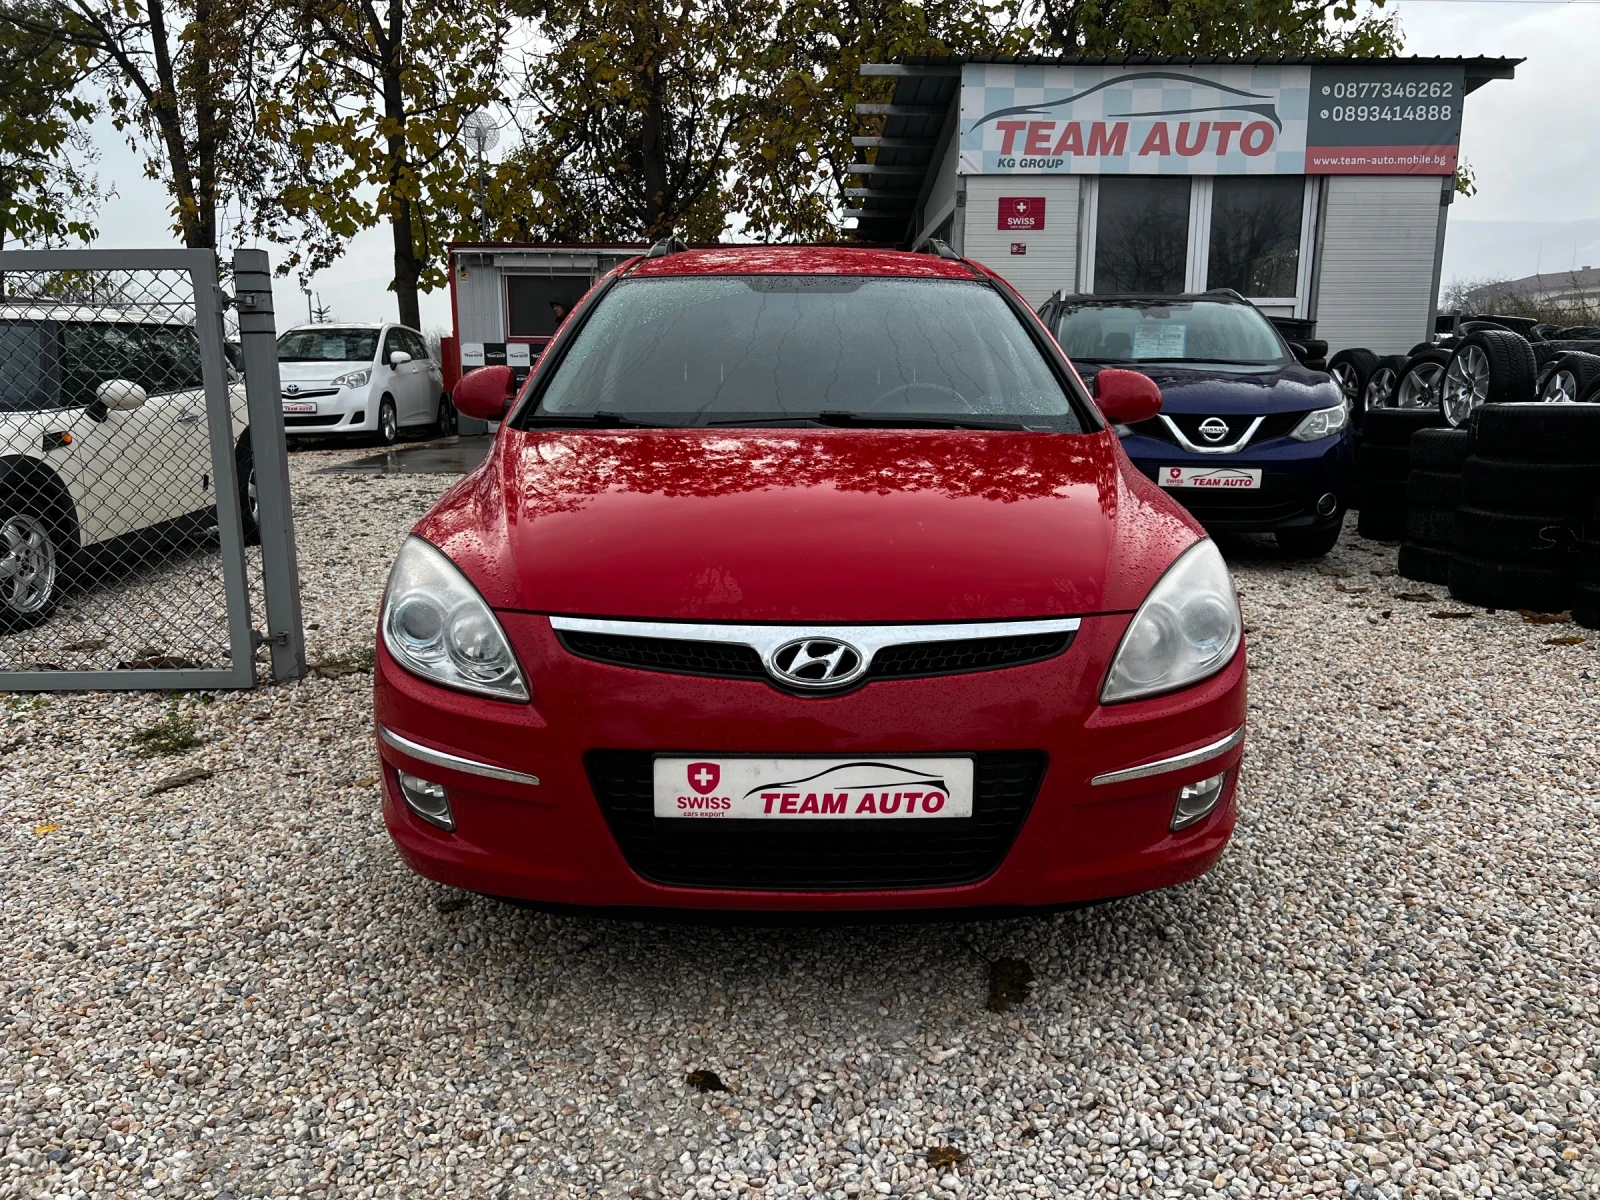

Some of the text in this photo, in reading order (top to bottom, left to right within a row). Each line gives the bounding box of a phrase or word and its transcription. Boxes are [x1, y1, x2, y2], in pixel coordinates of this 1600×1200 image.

[1334, 82, 1453, 98] 0877346262
[1332, 105, 1452, 121] 0893414888
[996, 121, 1274, 156] TEAM AUTO
[997, 158, 1064, 168] KG GROUP
[1313, 155, 1446, 165] www.team-auto.mobile.bg
[1007, 217, 1035, 225] SWISS
[1193, 478, 1252, 487] TEAM AUTO
[677, 796, 731, 810] SWISS
[760, 792, 945, 814] TEAM AUTO
